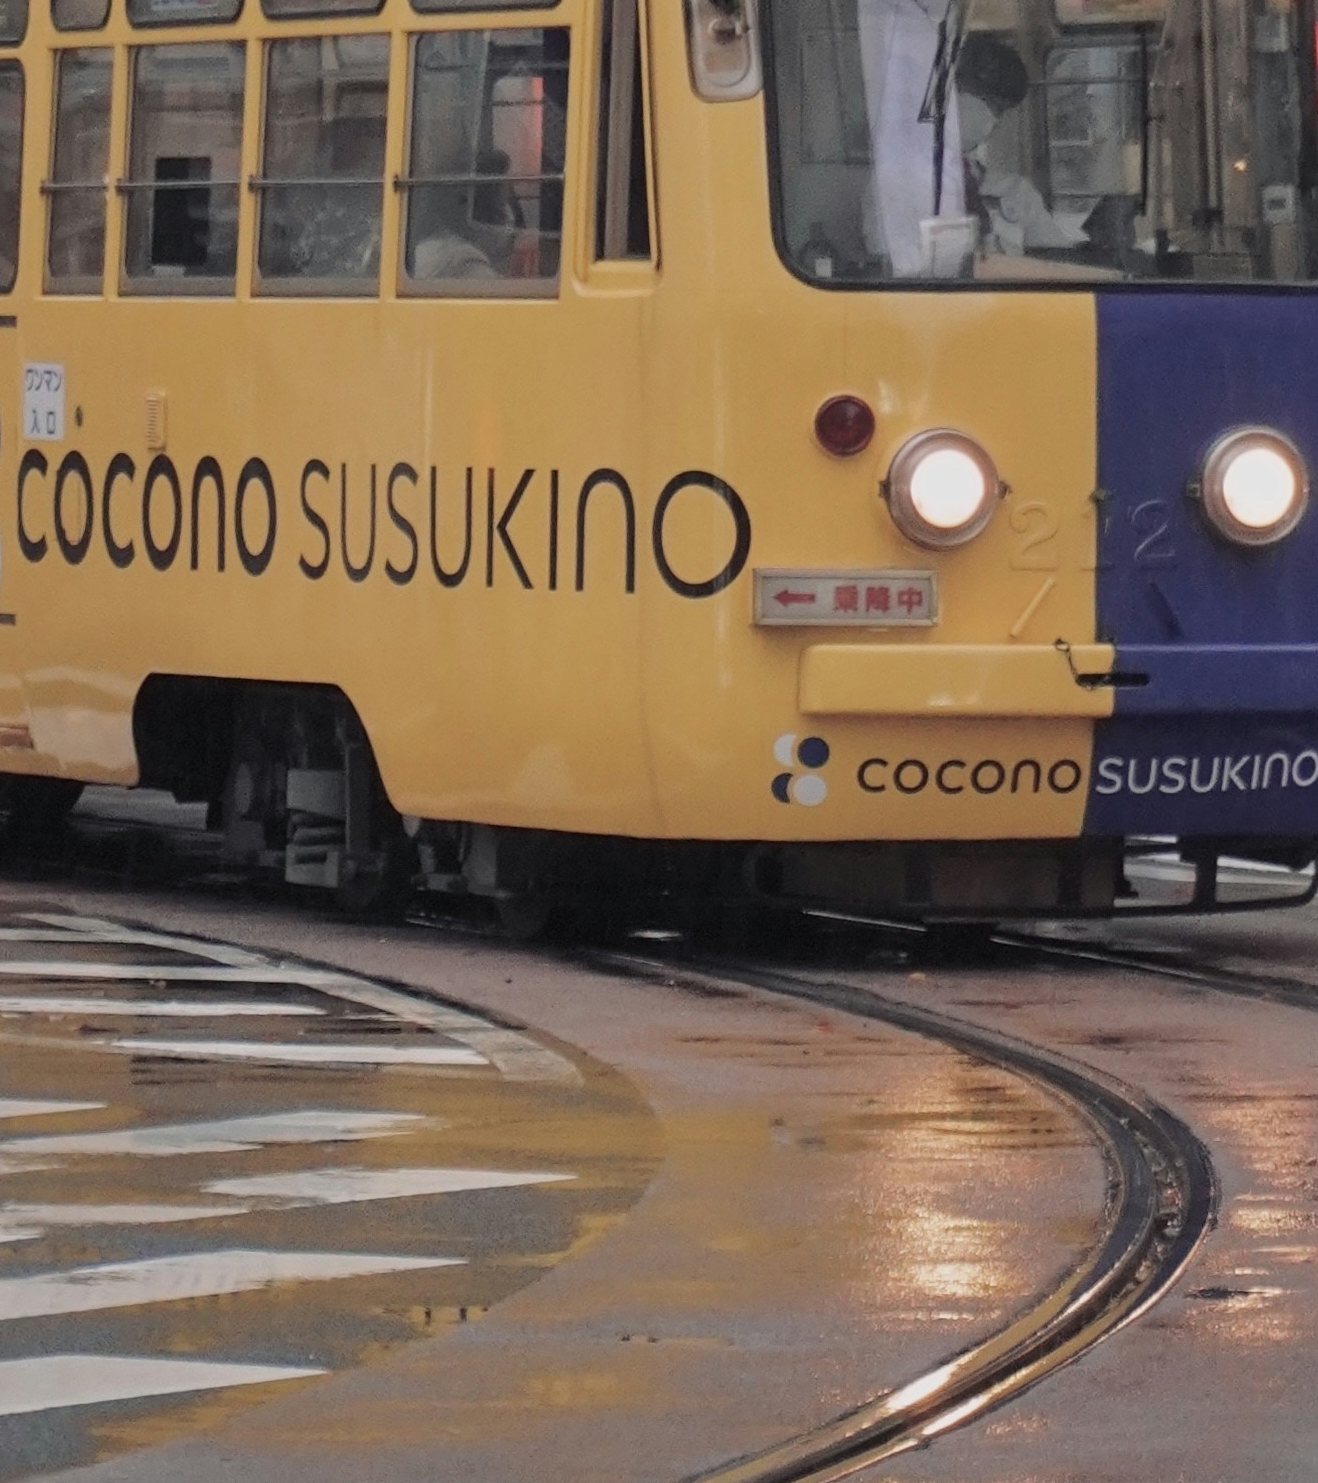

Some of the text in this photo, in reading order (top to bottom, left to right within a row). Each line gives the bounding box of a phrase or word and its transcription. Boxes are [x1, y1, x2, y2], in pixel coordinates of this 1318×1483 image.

[26, 368, 62, 393] ワンマン
[31, 409, 57, 434] 入口
[833, 585, 923, 615] 乗降中
